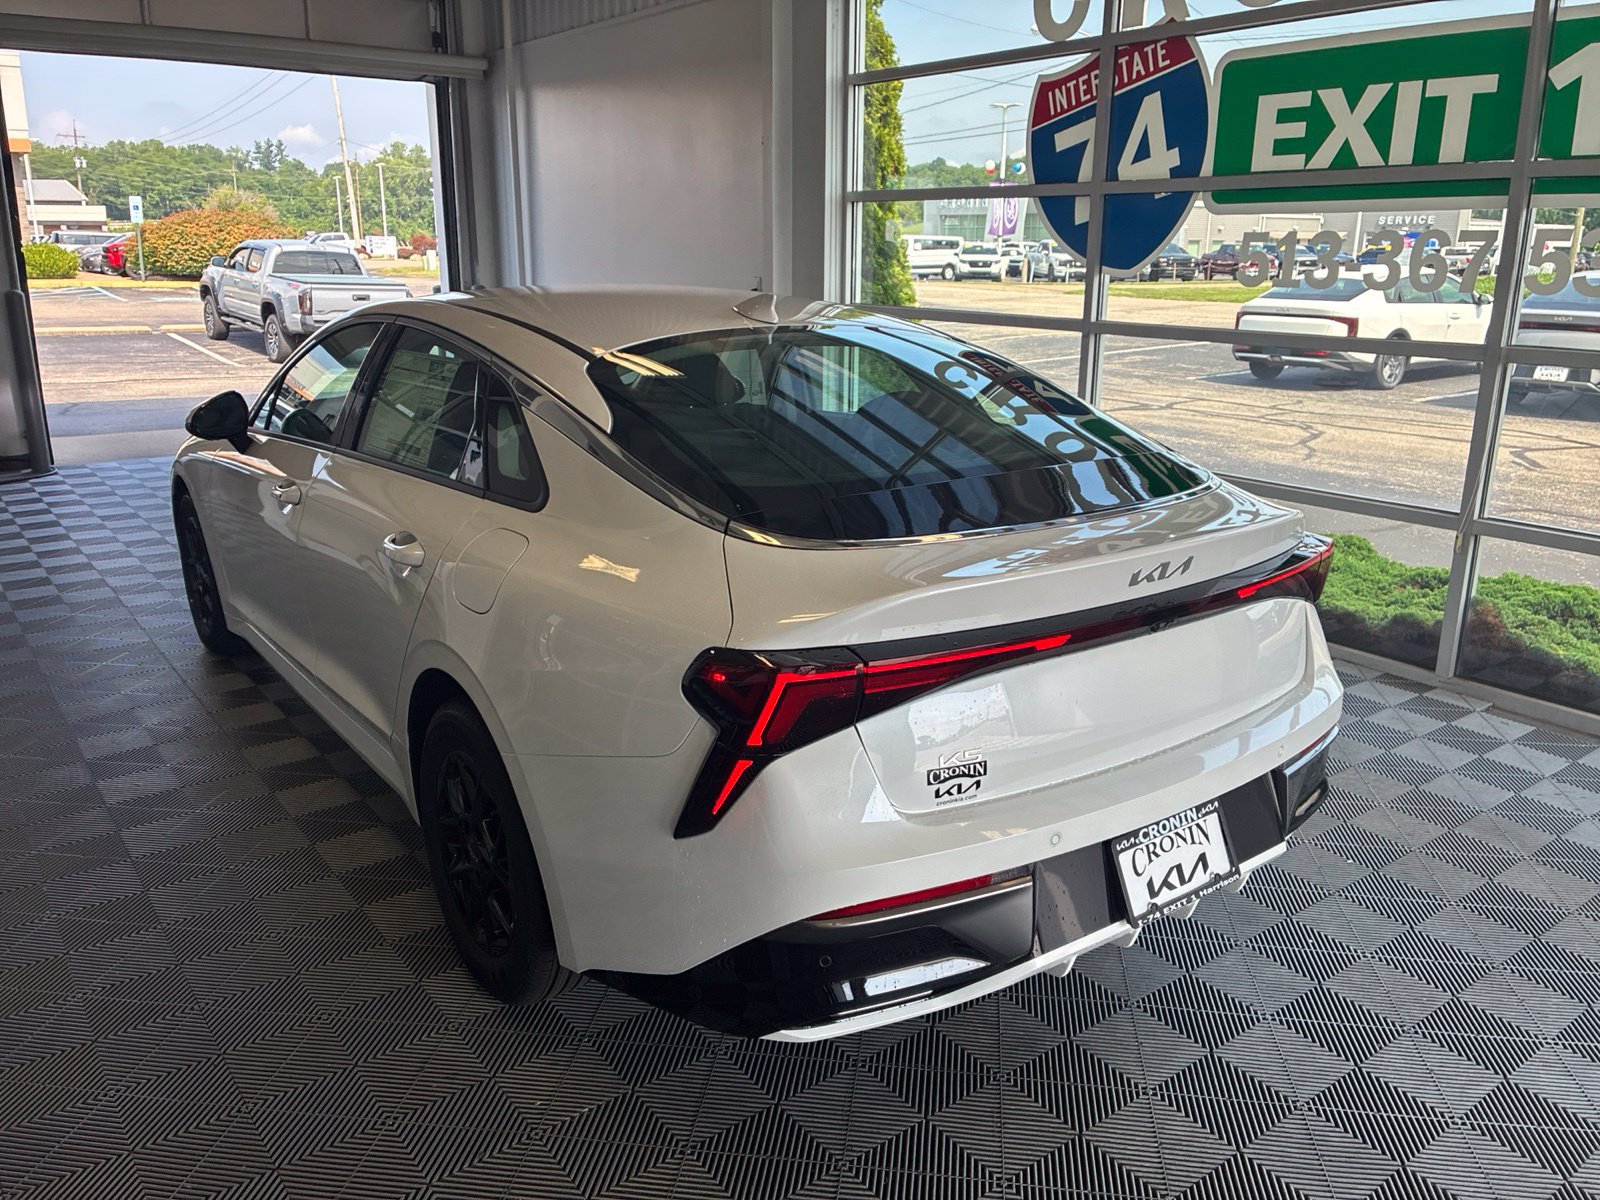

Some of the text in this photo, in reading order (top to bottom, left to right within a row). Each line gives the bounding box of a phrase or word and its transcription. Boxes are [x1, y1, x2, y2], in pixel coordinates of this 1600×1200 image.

[1048, 40, 1170, 116] INTERTATE
[1250, 73, 1499, 173] EXIT
[1054, 91, 1180, 225] 74
[1378, 215, 1436, 225] SERVICE
[1129, 555, 1194, 587] KIA
[930, 762, 985, 784] CRONIN
[935, 779, 981, 799] KIA
[936, 794, 978, 806] croninkia.com
[1140, 808, 1197, 843] CRONIN
[1132, 819, 1211, 877] CRONIN
[1146, 851, 1209, 900] KIA
[1137, 875, 1240, 928] I-74 EXIT 1 Harrison
